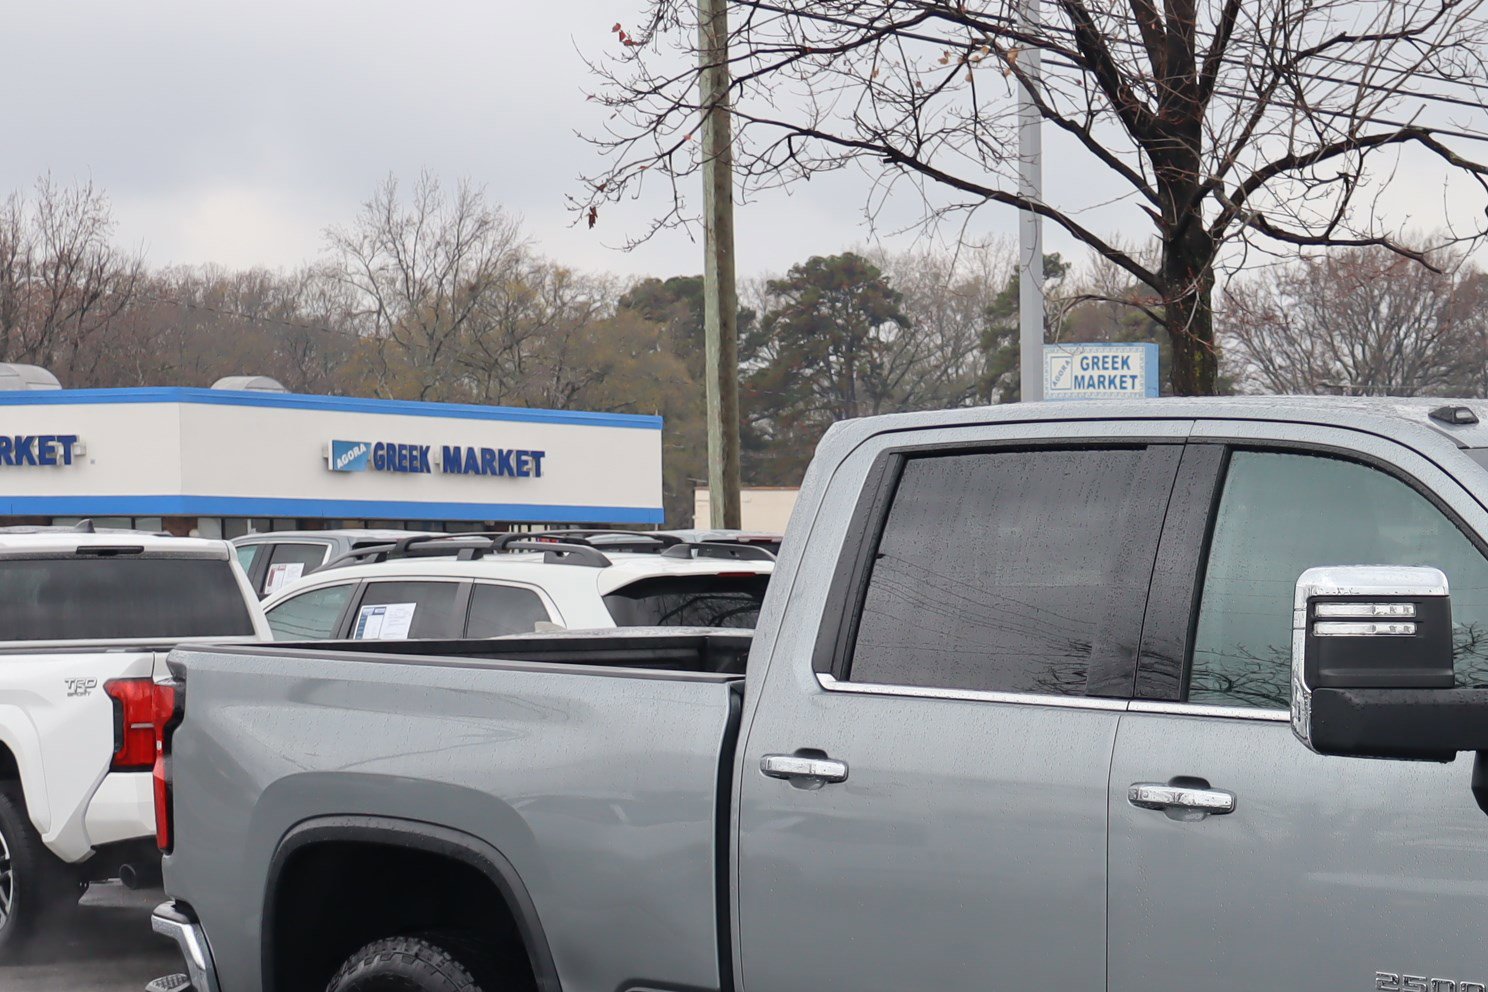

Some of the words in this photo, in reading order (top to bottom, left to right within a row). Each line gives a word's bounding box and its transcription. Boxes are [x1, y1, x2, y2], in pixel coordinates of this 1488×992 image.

[1080, 355, 1131, 371] GREEK
[1073, 375, 1138, 390] MARKET
[336, 443, 368, 469] AGORA
[373, 442, 431, 474] GREEK
[442, 445, 545, 478] MARKET
